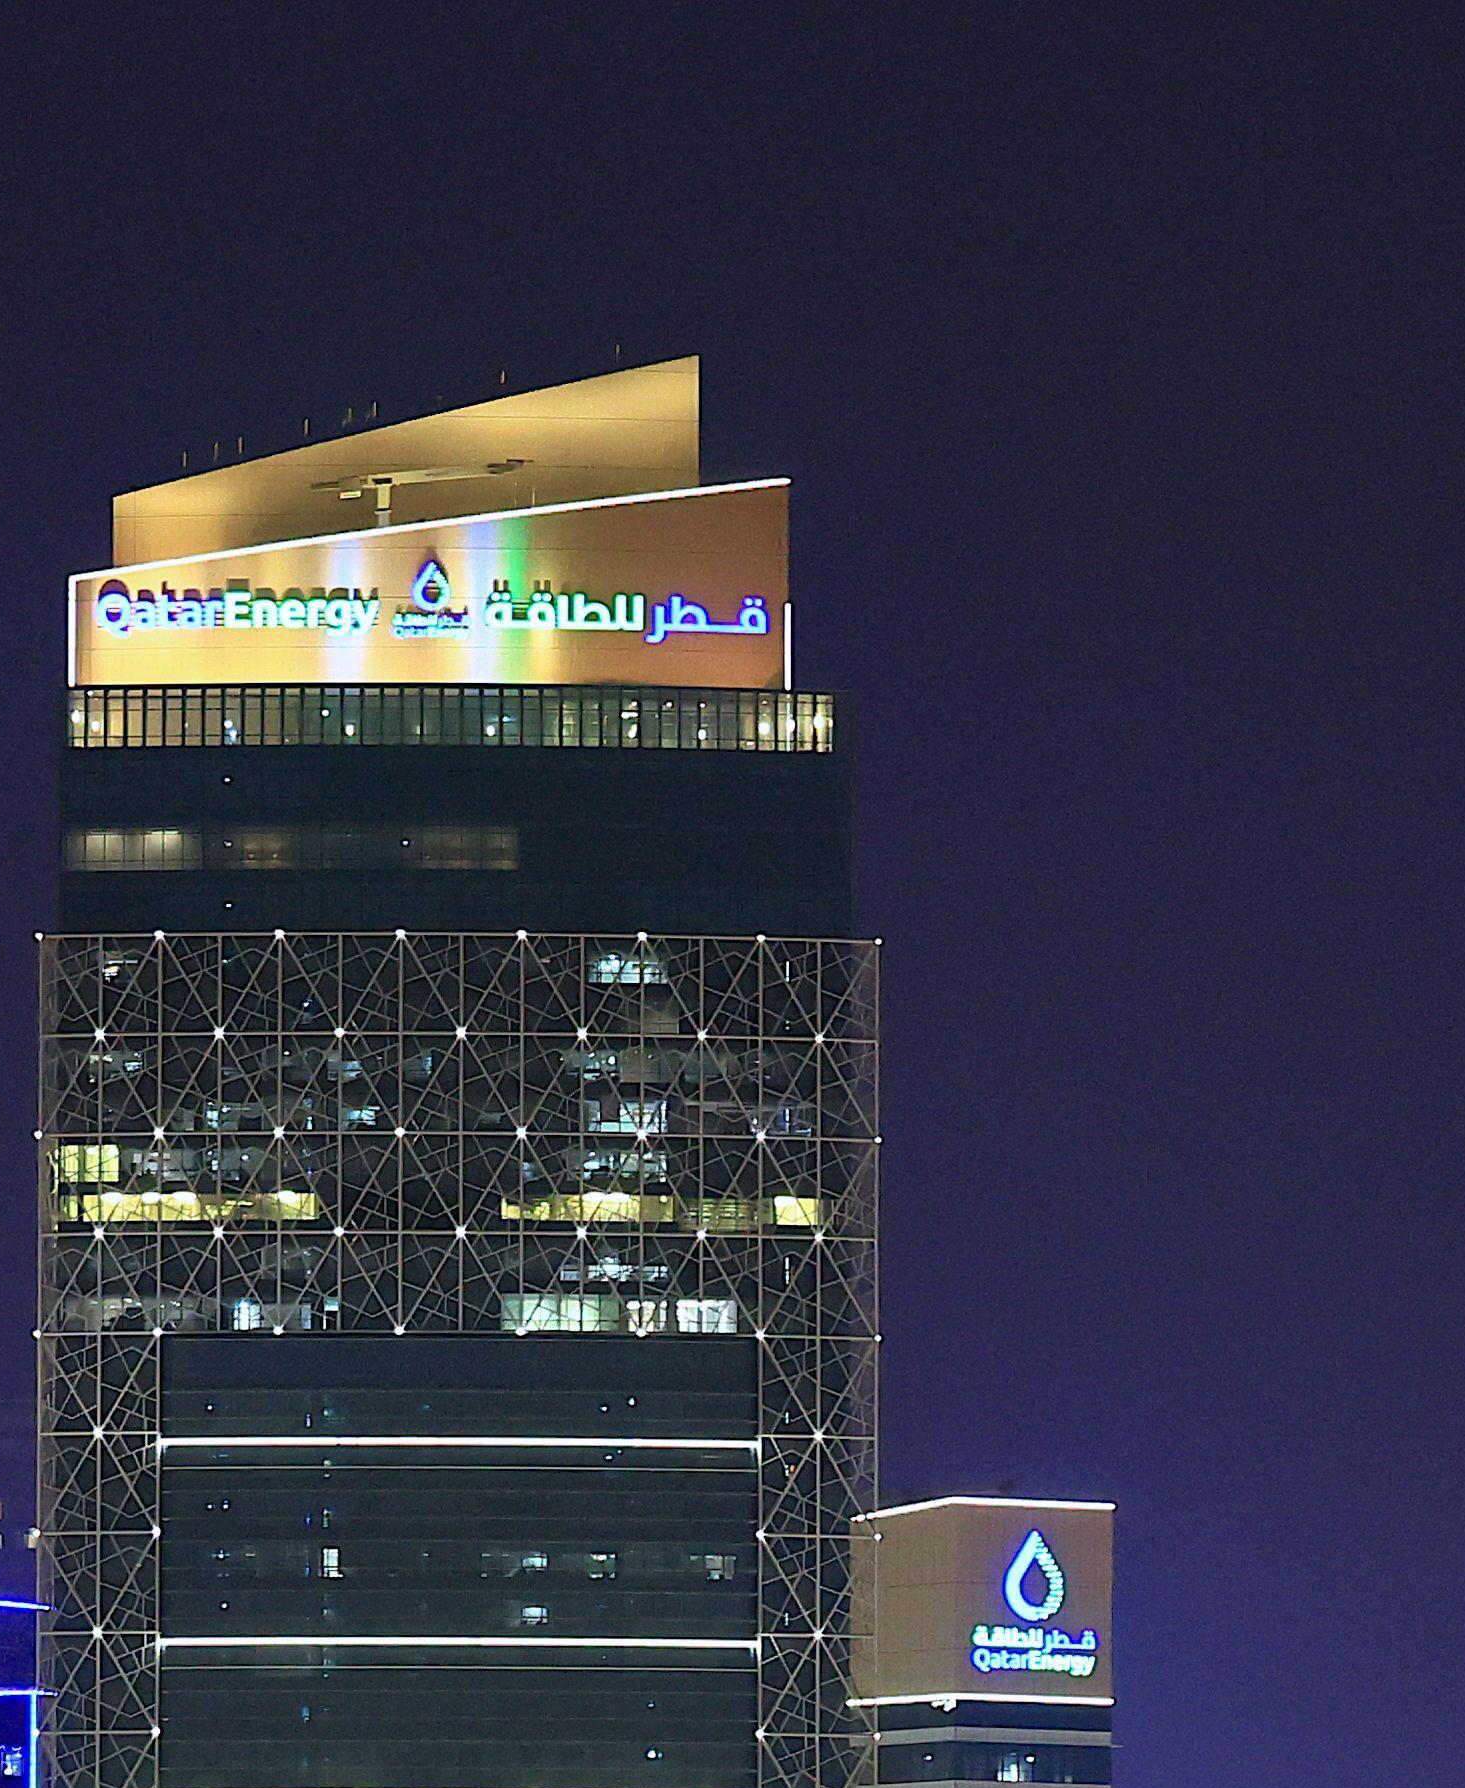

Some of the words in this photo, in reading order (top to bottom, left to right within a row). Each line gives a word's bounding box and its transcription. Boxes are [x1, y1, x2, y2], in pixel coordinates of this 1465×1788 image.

[96, 591, 380, 639] QatarEnergy
[485, 591, 645, 632] للطاقة
[643, 592, 771, 644] قطر
[1043, 1628, 1097, 1653] قطر
[972, 1647, 1097, 1677] QatarEnergy
